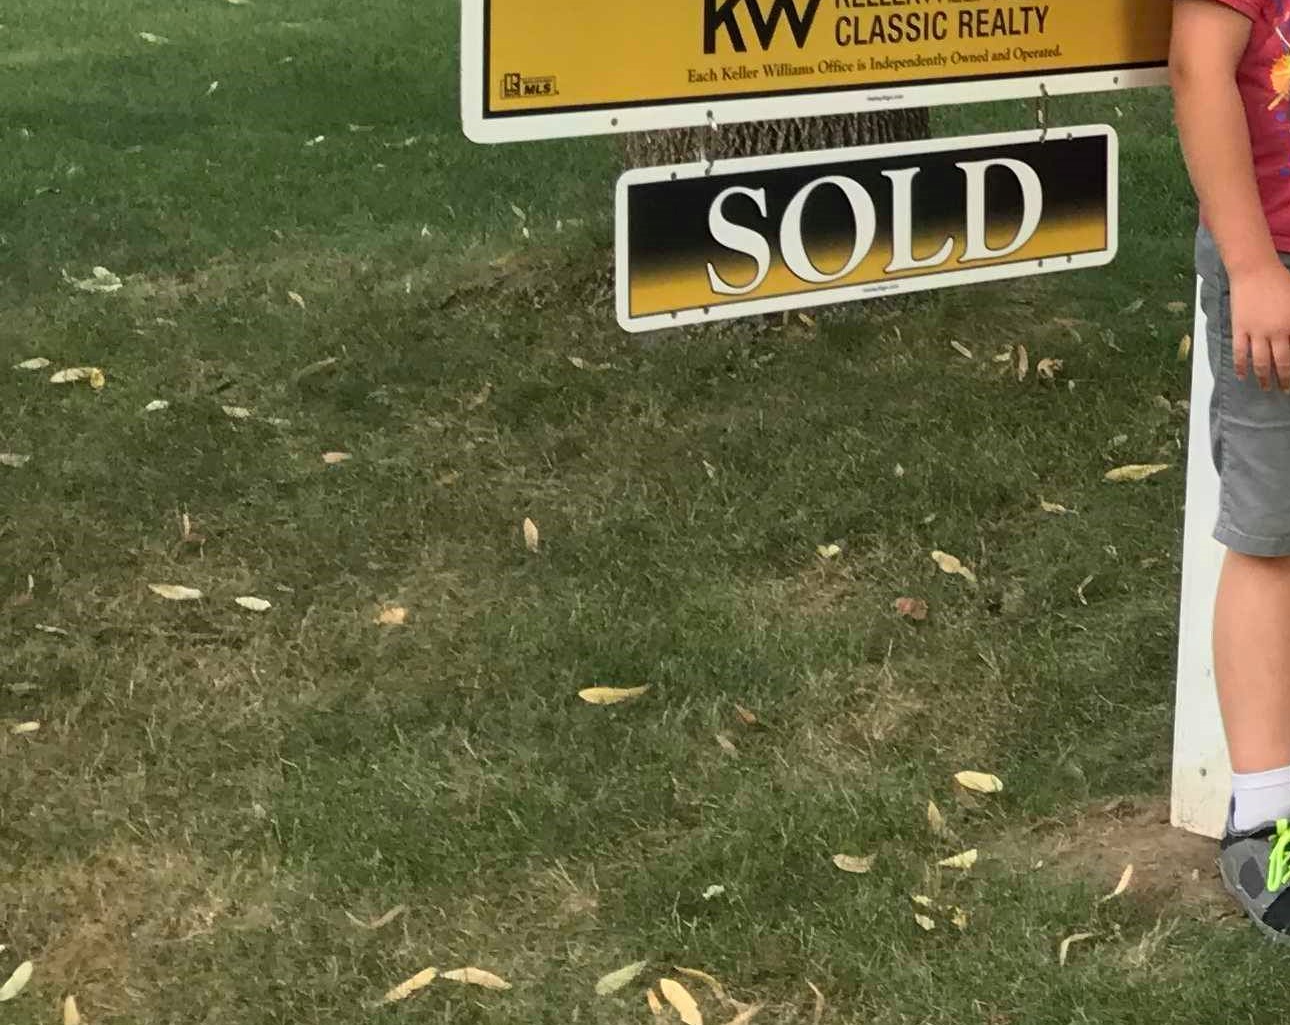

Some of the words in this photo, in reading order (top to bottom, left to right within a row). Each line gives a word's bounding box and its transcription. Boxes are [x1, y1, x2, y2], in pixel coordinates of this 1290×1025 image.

[835, 11, 948, 46] CLASSIC
[958, 5, 1049, 39] REALTY
[687, 68, 718, 83] Each
[721, 65, 759, 81] Keller
[763, 62, 815, 78] Williams
[818, 59, 853, 74] Office
[857, 58, 867, 71] is
[870, 52, 947, 71] Independently
[951, 49, 989, 65] Owned
[992, 47, 1010, 61] and
[1013, 44, 1062, 62] Operated.
[706, 158, 1044, 296] SOLD
